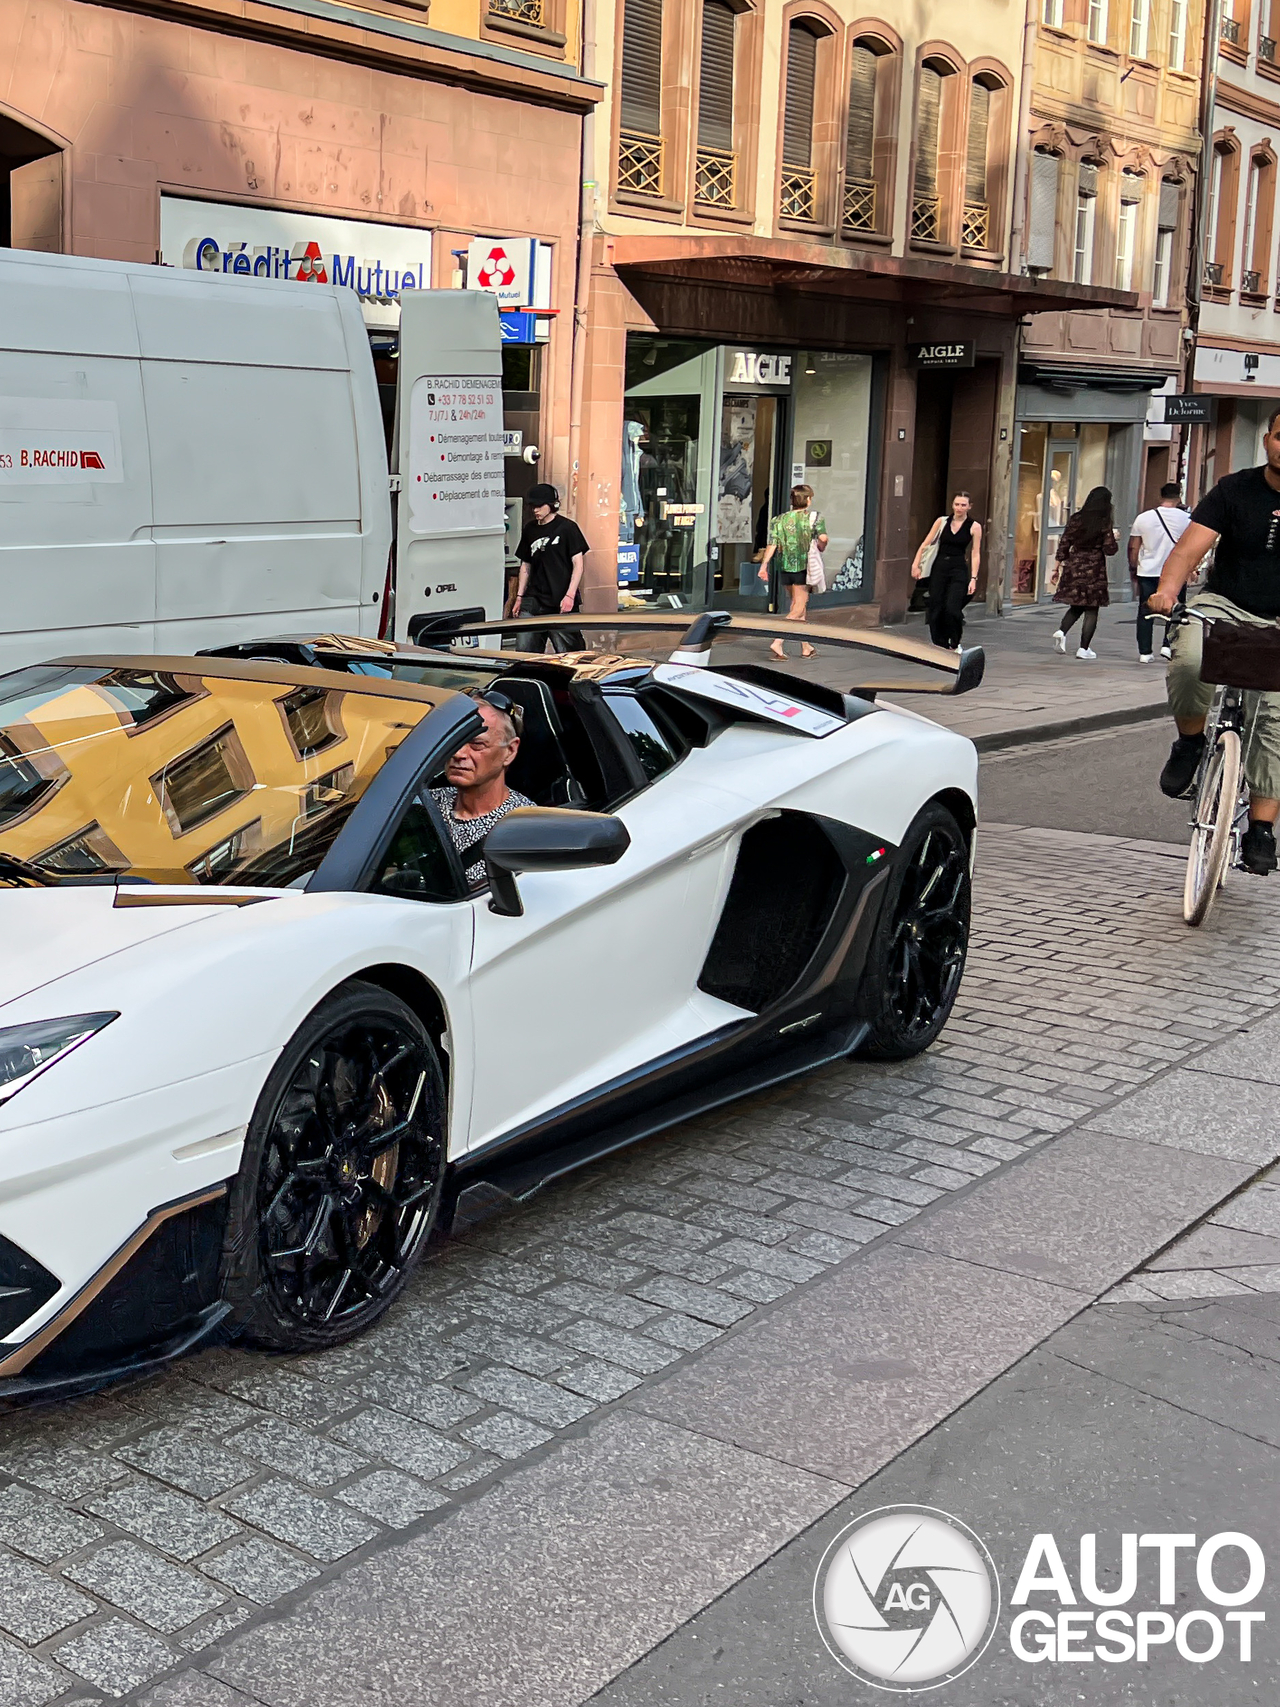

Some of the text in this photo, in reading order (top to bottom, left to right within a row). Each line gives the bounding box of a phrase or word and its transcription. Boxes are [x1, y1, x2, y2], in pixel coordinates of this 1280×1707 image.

[195, 236, 424, 298] Crédit Mutuel
[498, 291, 521, 299] Mutuel
[917, 345, 965, 358] AIGLE
[730, 352, 792, 386] AIGLE
[426, 379, 460, 389] B.RACHID
[438, 394, 494, 406] +33 7 78 52 51 53
[1178, 399, 1199, 408] Yves
[450, 409, 457, 421] &
[1168, 407, 1207, 416] Delorme
[0, 454, 13, 469] 53
[20, 450, 78, 469] B.RACHID
[447, 451, 483, 464] Démontage
[485, 451, 490, 461] &
[471, 470, 482, 480] des
[482, 488, 489, 497] de
[435, 583, 458, 594] OPEL
